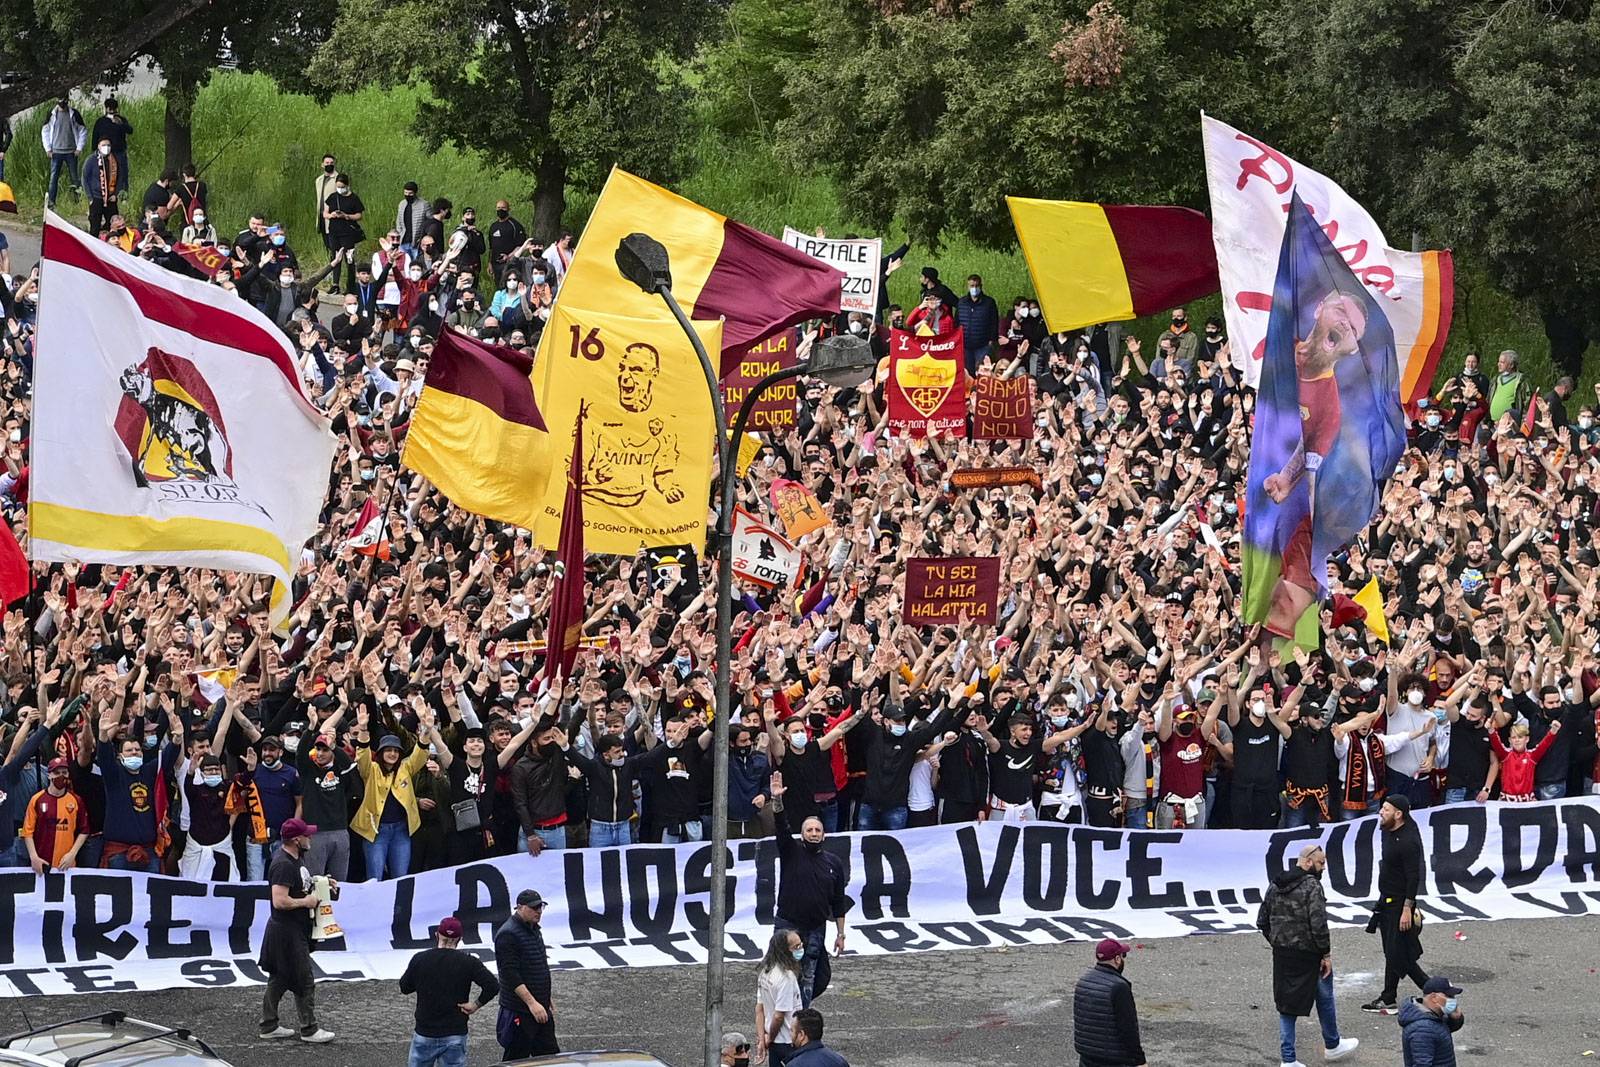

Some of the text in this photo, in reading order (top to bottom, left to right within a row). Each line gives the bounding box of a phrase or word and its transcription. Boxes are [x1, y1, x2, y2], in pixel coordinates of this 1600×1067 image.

[569, 324, 605, 361] 16
[767, 336, 787, 353] LA
[740, 361, 780, 378] ROMA
[977, 374, 1028, 398] SIAMO
[726, 387, 743, 403] IN
[977, 398, 1028, 419] SOLO
[755, 409, 793, 426] CUOR
[908, 418, 926, 429] non
[981, 422, 1018, 438] NOI
[544, 505, 562, 520] ERA
[592, 522, 627, 534] SOGNO
[628, 525, 643, 535] FIN
[659, 520, 700, 536] BAMBINO
[753, 564, 789, 584] roma
[926, 564, 977, 580] TU SEI
[924, 583, 976, 599] LA MIA
[910, 601, 988, 617] MALATTIA
[1351, 752, 1363, 788] ROMA
[389, 863, 512, 950] LA
[563, 833, 912, 942] NOSTA
[1265, 803, 1600, 898] GURDA
[851, 916, 1135, 952] ROMA
